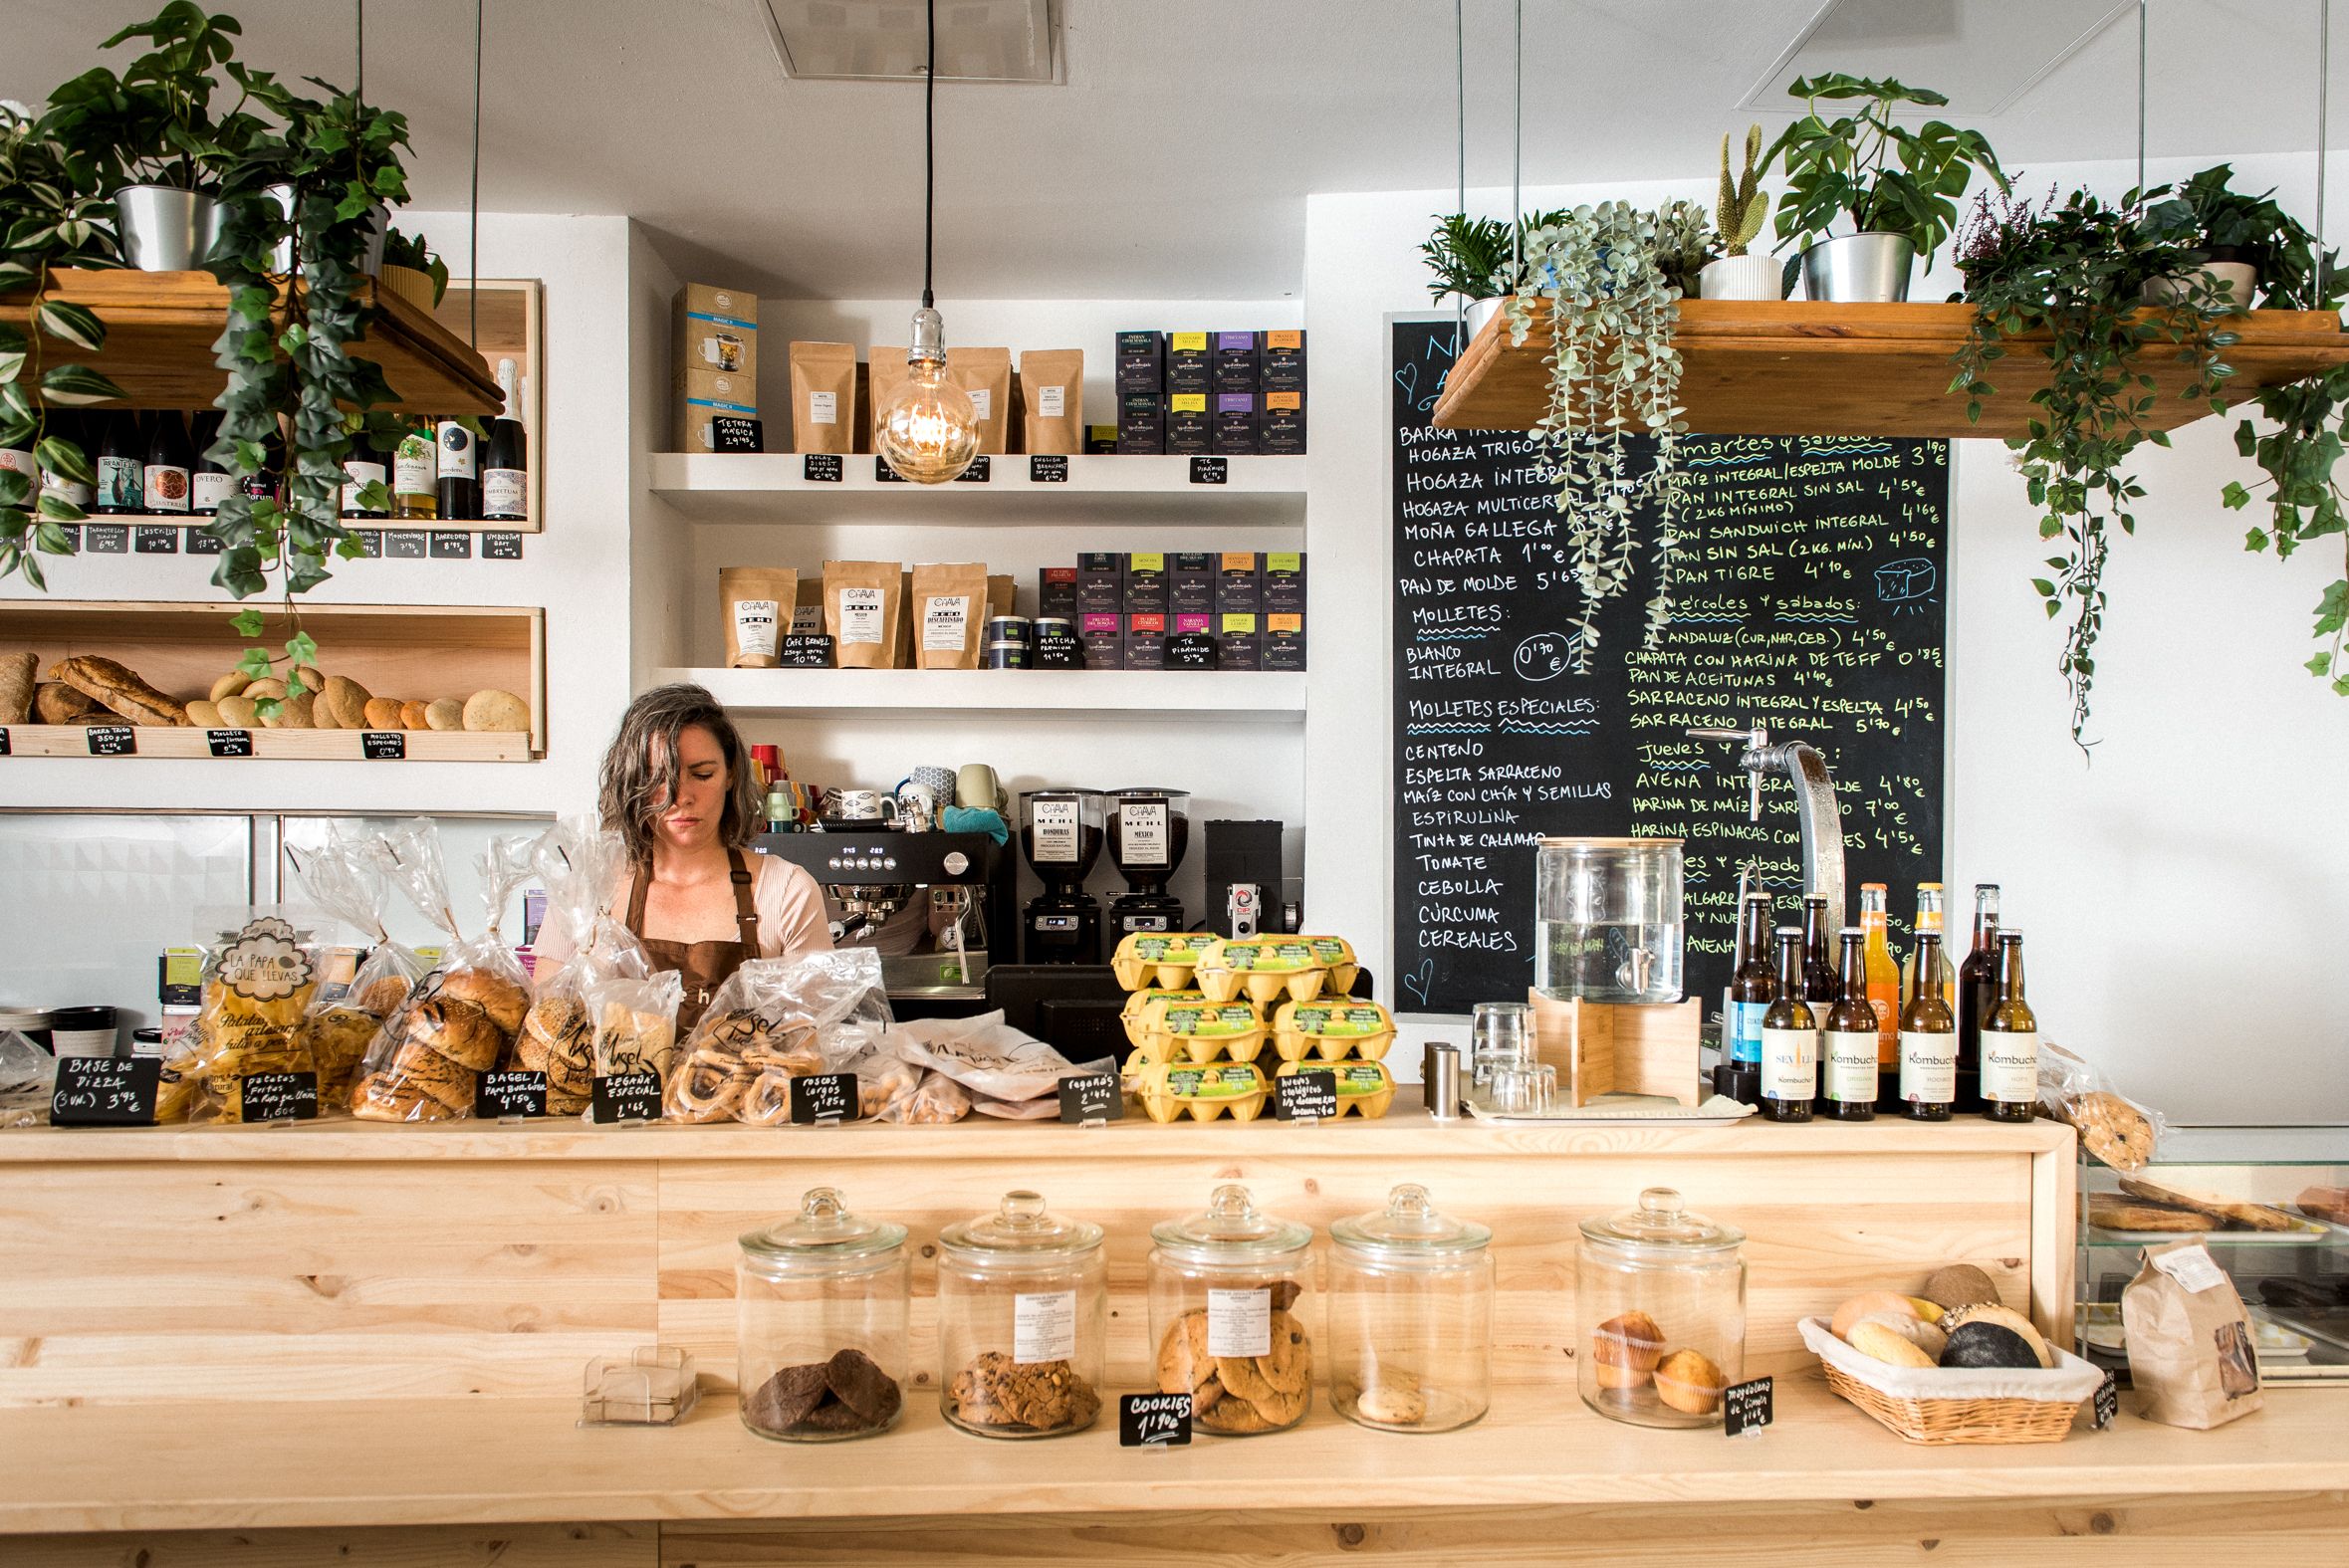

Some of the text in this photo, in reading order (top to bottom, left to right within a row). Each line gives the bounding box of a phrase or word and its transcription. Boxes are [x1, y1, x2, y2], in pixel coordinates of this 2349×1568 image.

[1408, 445, 1478, 464] HOGAZA
[1482, 439, 1533, 458] TRIGO
[1683, 434, 1774, 457] martes
[1852, 455, 1901, 471] MOLDE
[1406, 472, 1484, 493] HOGAZA
[1670, 490, 1705, 505] PAN
[1715, 486, 1798, 503] INTEGRAL
[1803, 484, 1831, 498] SIN
[1835, 480, 1865, 495] SAL
[1402, 500, 1470, 519] HOGAZA
[1405, 522, 1456, 541] MOÑA
[1465, 519, 1558, 539] GALLEGA
[1709, 520, 1808, 540] SANDWICH
[1815, 513, 1890, 531] INTEGRAL
[1414, 547, 1503, 567] CHAPATA
[1707, 545, 1738, 560] SIN
[1747, 543, 1784, 560] SAL
[1675, 566, 1709, 583] PAN
[1715, 564, 1776, 581] TIGRE
[1400, 576, 1432, 596] PAN
[1436, 579, 1457, 596] DE
[1463, 574, 1519, 592] MOLDE
[1406, 645, 1462, 664] BLANCO
[1624, 650, 1687, 667] CHAPATA
[1694, 653, 1725, 667] CON
[1731, 652, 1797, 668] HARINA
[1809, 652, 1830, 667] DE
[1832, 652, 1884, 667] TEFF
[1407, 659, 1502, 681] INTEGRAL
[1629, 667, 1661, 684] PAN
[1664, 669, 1680, 684] DE
[1684, 671, 1775, 687] ACEITUNAS
[1409, 699, 1494, 720] MOLLETES
[1626, 689, 1730, 706] SARRACENO
[1737, 693, 1810, 711] INTEGRAL
[1822, 699, 1884, 716] ESPELTA
[1629, 713, 1833, 731] SARRACENO INTEGRAL
[1405, 738, 1484, 762] CENTENO
[1405, 764, 1562, 784] ESPELTA SARRACENO
[1634, 772, 1702, 788] AVENA
[1403, 786, 1443, 804] MAÍZ
[1447, 786, 1476, 802] CON
[1481, 785, 1518, 802] CHÍA
[1539, 782, 1612, 801] SEMILLAS
[1632, 795, 1686, 814] HARINA
[1691, 797, 1710, 812] DE
[1713, 795, 1750, 812] MAÍZ
[1412, 808, 1521, 826] ESPIRULINA
[1409, 833, 1474, 848] TINTA DE
[1631, 821, 1688, 839] HARINA
[1692, 821, 1769, 842] ESPINACAS
[1773, 828, 1800, 845] CON
[1415, 854, 1488, 872] TOMATE
[1418, 877, 1505, 896] CEBOLLA
[1418, 902, 1501, 924] CÚRCUMA
[1418, 930, 1518, 952] CEREALES
[69, 1059, 133, 1073] BASE DE
[487, 1072, 531, 1085] BAGEL
[803, 1075, 837, 1087] roscos
[484, 1085, 506, 1096] PAN
[607, 1085, 661, 1098] ESPECIAL
[1130, 1395, 1192, 1419] COOKIES
